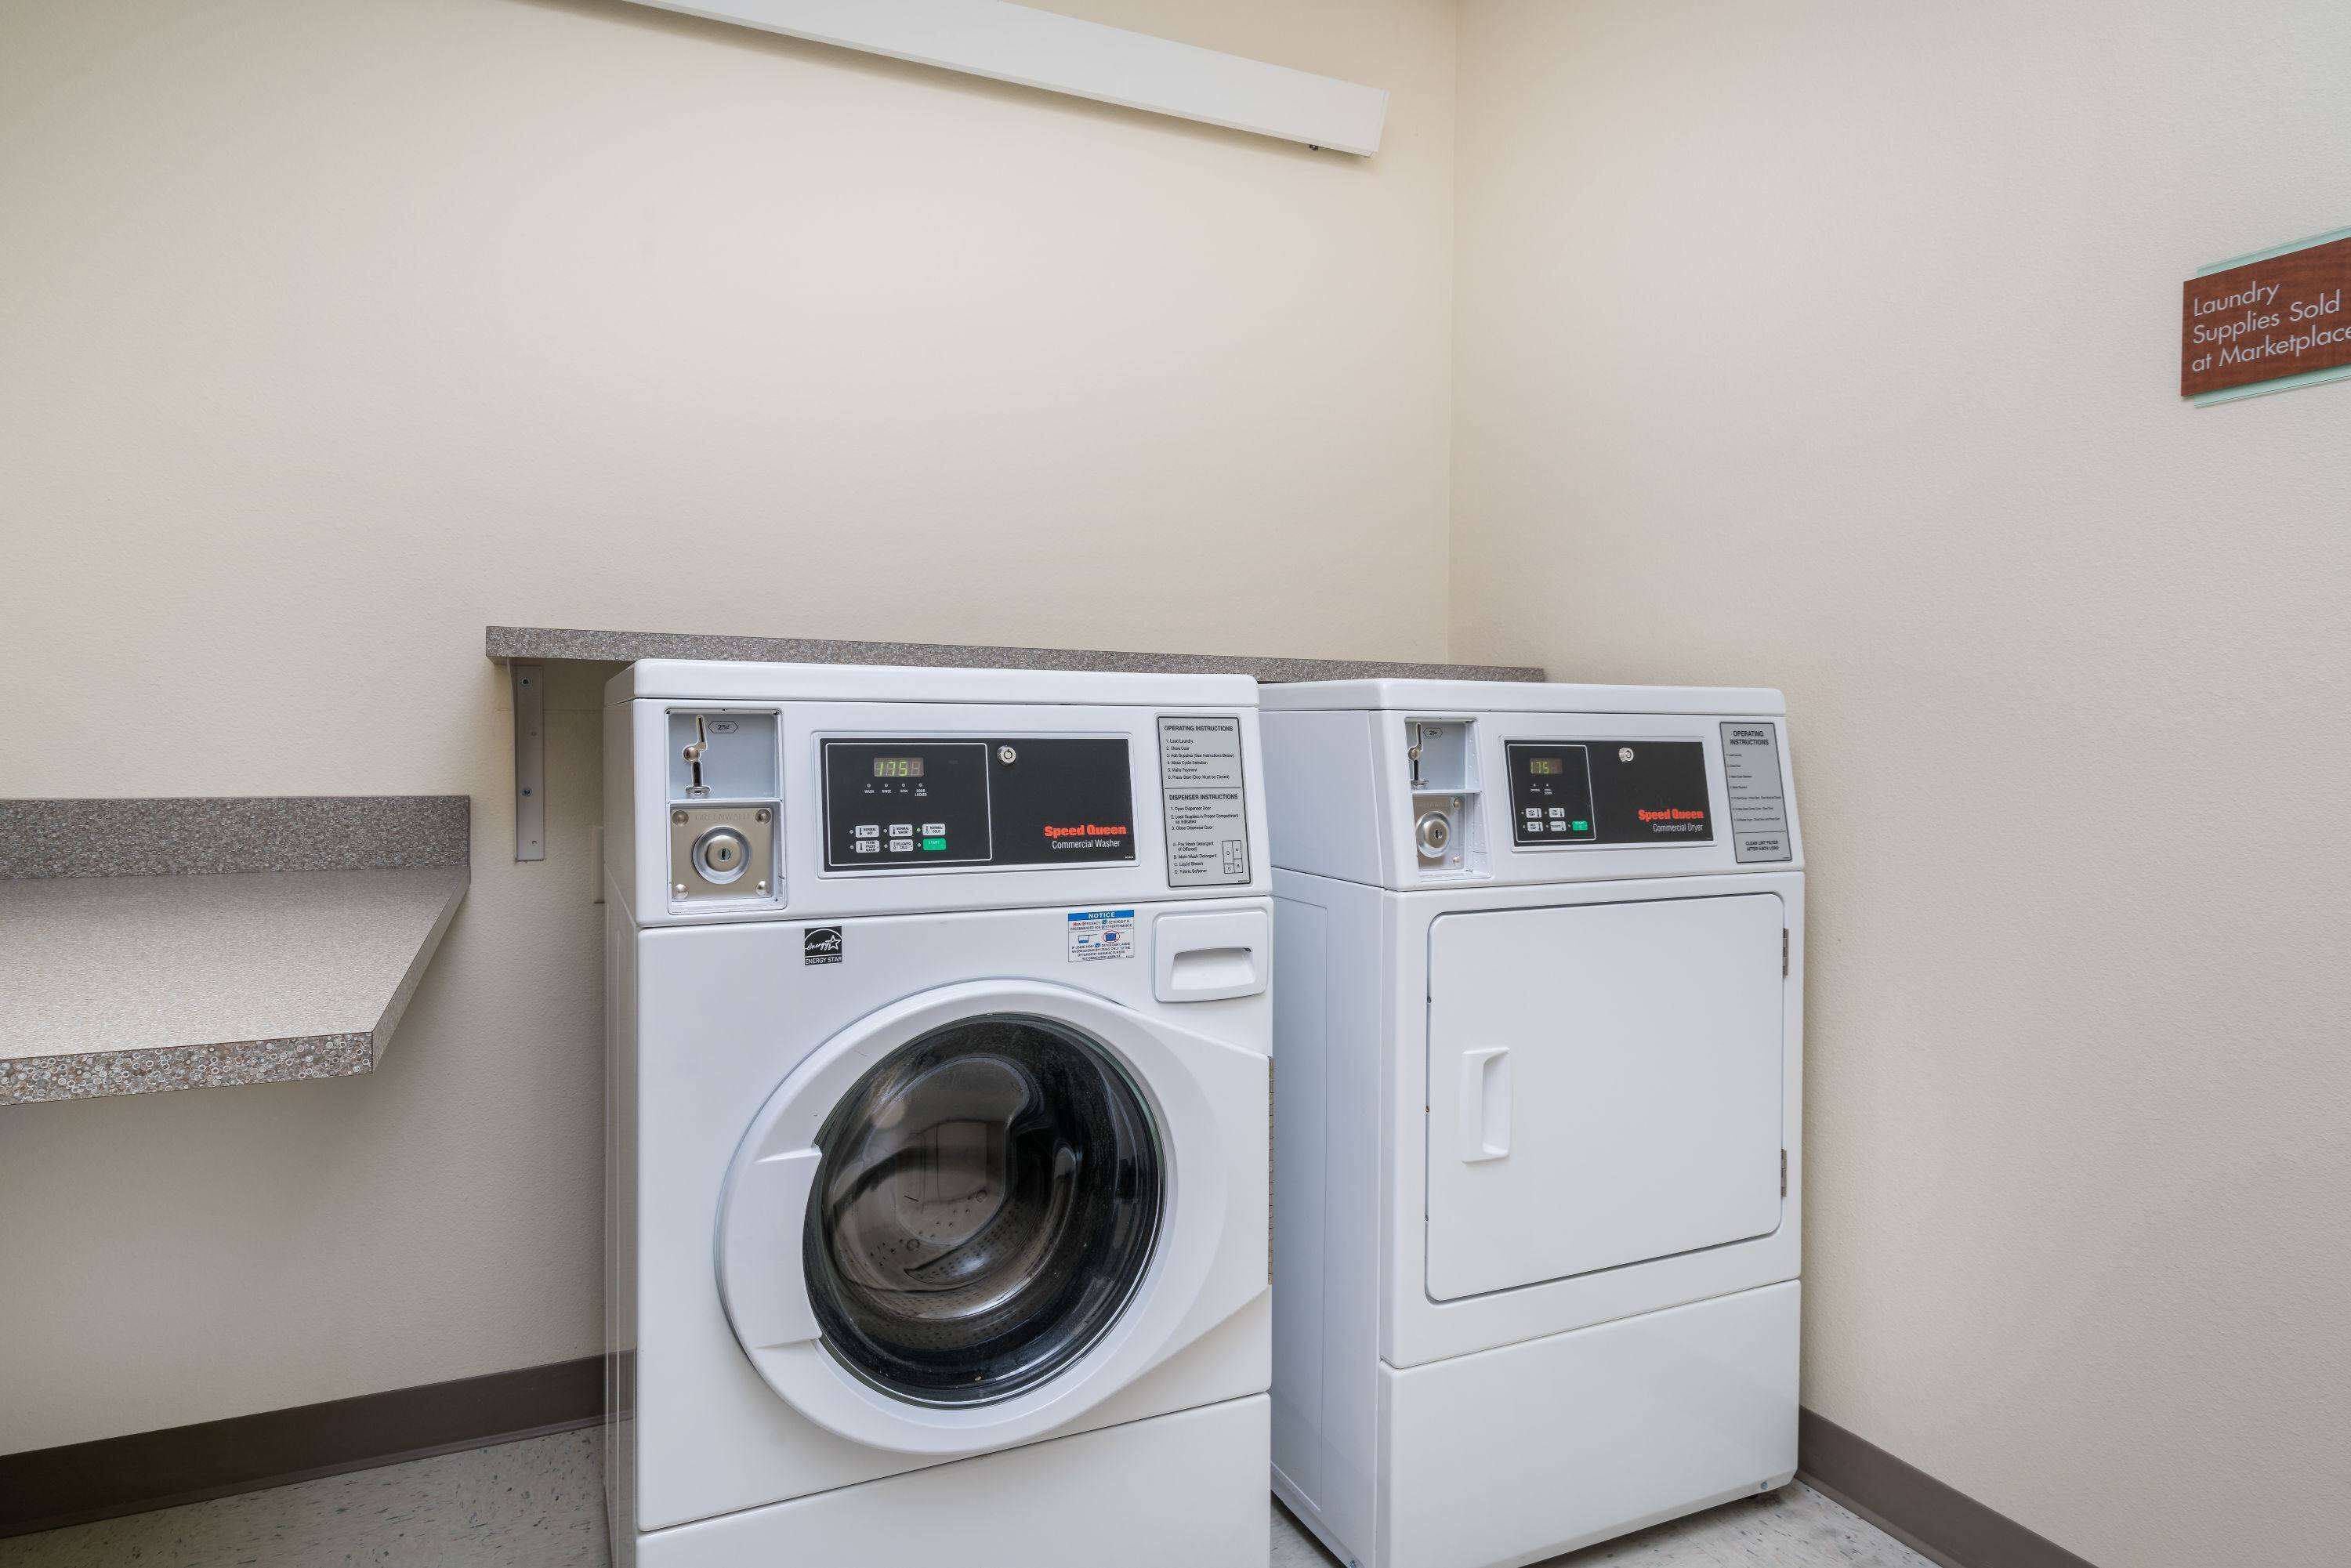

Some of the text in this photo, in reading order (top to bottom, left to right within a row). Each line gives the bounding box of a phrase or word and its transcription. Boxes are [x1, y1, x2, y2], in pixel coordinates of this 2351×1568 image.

[2194, 281, 2281, 317] Laundry
[2193, 289, 2341, 344] Supplies Sold
[2191, 353, 2212, 372] at
[1638, 809, 1704, 822] Speed Queen
[1044, 824, 1127, 838] Speed Queen
[1687, 823, 1704, 832] Dryer
[1052, 838, 1121, 849] Commercial Washer
